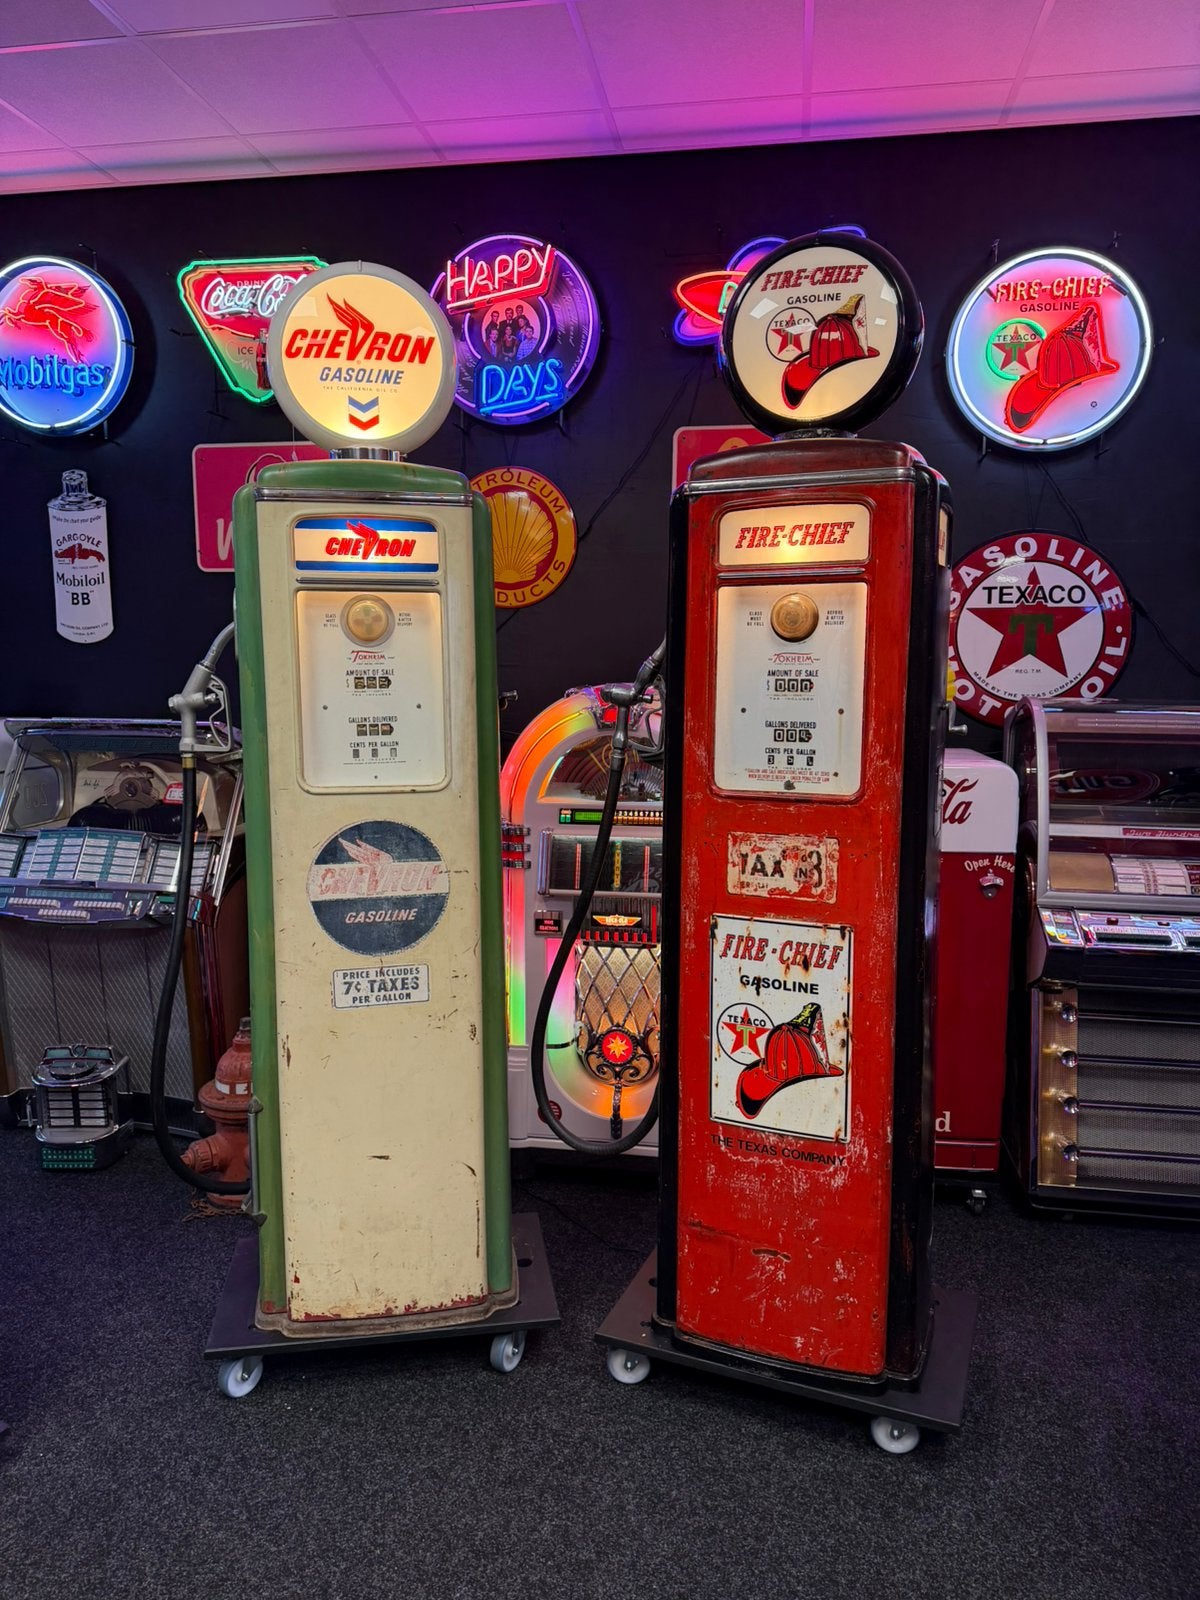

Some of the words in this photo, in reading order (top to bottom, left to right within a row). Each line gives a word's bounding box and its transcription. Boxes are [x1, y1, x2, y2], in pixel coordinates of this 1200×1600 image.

[447, 244, 555, 303] HAPPY
[761, 265, 868, 292] FIRE-CHIEF
[996, 274, 1111, 303] FIRE-CHIEF
[787, 293, 842, 305] GASOLINE
[1020, 302, 1079, 312] GASOLINE
[774, 318, 810, 328] TEXACO
[285, 322, 435, 364] CHEVRON
[996, 334, 1036, 342] TEXACO
[238, 347, 254, 355] ICE
[320, 367, 404, 385] GASOLINE
[481, 358, 561, 405] DAYS
[472, 470, 566, 514] TROLEUM
[56, 533, 102, 548] GARGOYLE
[735, 522, 855, 548] FIRE-CHIEF
[325, 531, 416, 560] CHEVRON
[56, 572, 105, 587] Mobiloil
[983, 585, 1086, 604] TEXACO
[1008, 614, 1054, 656] T
[772, 652, 814, 664] TOKHEIM
[1080, 637, 1126, 701] OIL
[973, 671, 989, 688] MADE
[991, 686, 1001, 694] BY
[1003, 689, 1018, 698] THE
[1048, 672, 1083, 695] COMPANY
[790, 721, 816, 729] DELIVERED
[964, 858, 990, 871] Open
[994, 855, 1016, 873] Here
[318, 857, 438, 896] CHEVRON
[345, 908, 418, 924] GASOLINE
[343, 971, 370, 980] PRICE
[375, 967, 420, 978] INCLUDES
[343, 981, 361, 995] 7¢
[368, 977, 419, 992] TAXES
[740, 975, 819, 994] GASOLINE
[352, 995, 370, 1004] PER
[376, 993, 411, 1002] GALLON
[727, 1014, 766, 1027] TEXACO
[736, 1026, 755, 1045] T
[711, 1134, 733, 1147] THE
[737, 1140, 777, 1156] TEXAS
[782, 1148, 845, 1166] COMPANY
